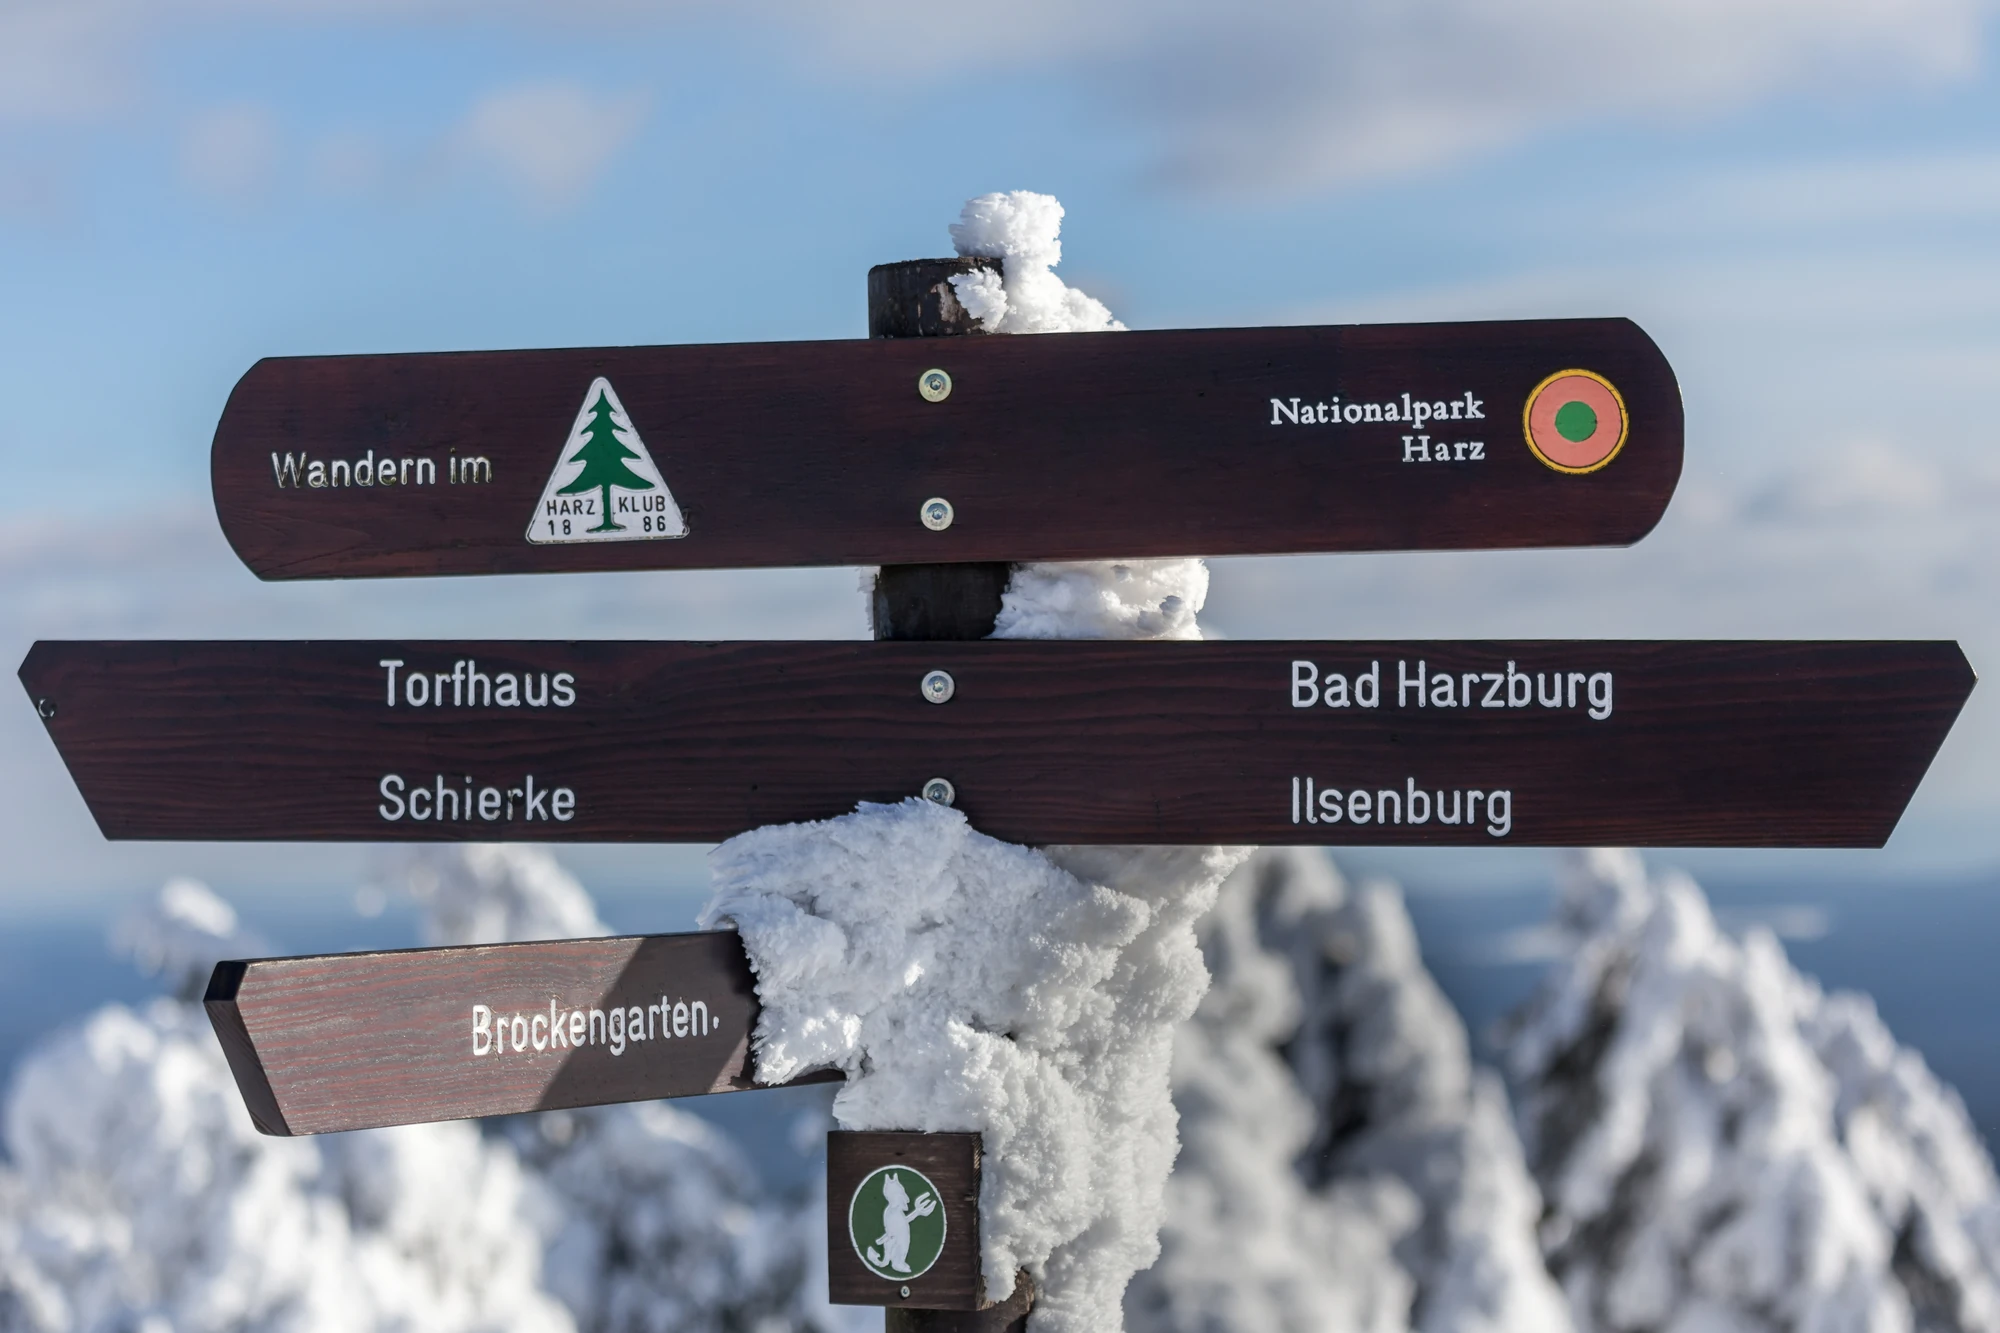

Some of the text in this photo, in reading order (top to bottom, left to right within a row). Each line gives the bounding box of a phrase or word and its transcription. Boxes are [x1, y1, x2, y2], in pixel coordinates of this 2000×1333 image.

[1270, 391, 1486, 429] Nationalpark
[271, 448, 493, 488] Wandern im
[1402, 435, 1486, 463] Harz
[546, 495, 666, 516] HARZ KLUB
[548, 515, 666, 536] 18 86
[379, 659, 577, 707] Torfhaus
[1291, 660, 1613, 721] Bad Harzburg
[379, 774, 576, 821] Schierke
[1292, 776, 1512, 837] Ilsenburg
[472, 995, 720, 1056] Brockengarten.
